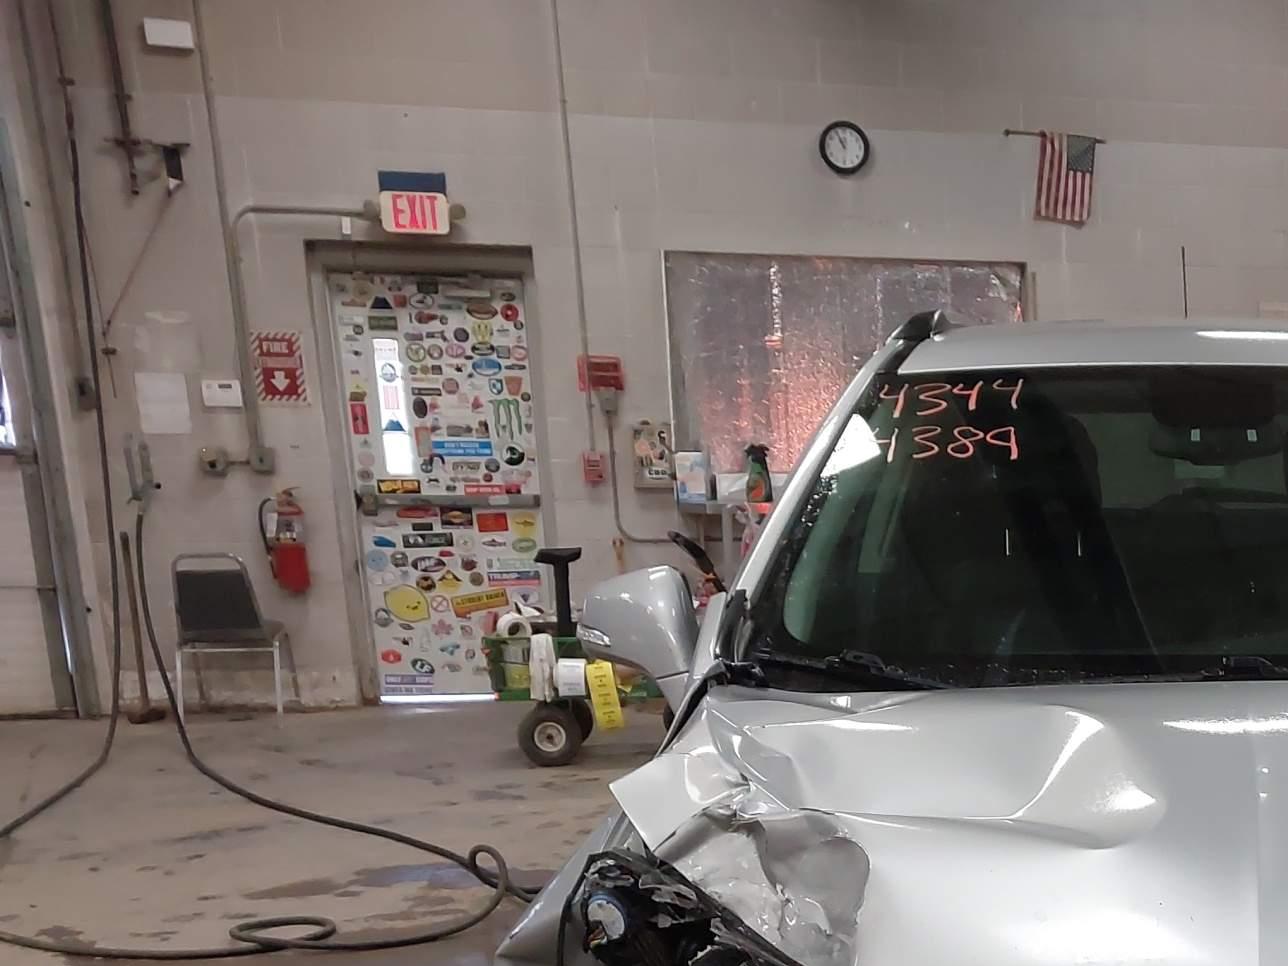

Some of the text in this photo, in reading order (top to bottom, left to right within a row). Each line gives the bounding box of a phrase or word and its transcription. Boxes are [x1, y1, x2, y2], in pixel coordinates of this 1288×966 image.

[391, 193, 438, 231] EXIT
[262, 341, 289, 354] FIRE
[879, 378, 1025, 418] 4344
[872, 425, 1019, 463] 4389
